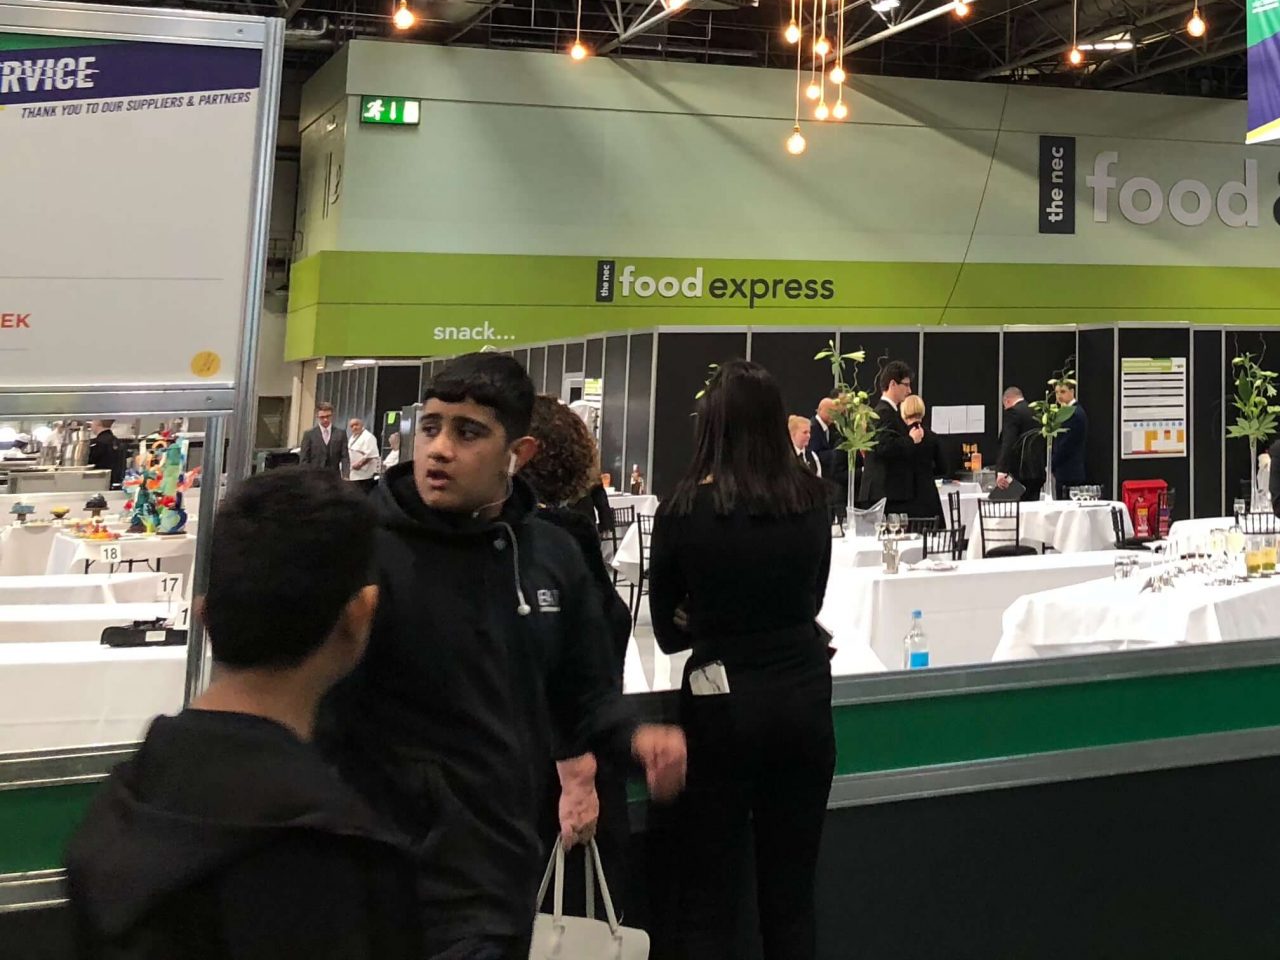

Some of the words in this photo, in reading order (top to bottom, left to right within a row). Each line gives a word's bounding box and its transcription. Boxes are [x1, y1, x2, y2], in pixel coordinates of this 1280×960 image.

[21, 106, 57, 119] THANK
[62, 104, 82, 116] YOU
[86, 102, 100, 114] TO
[101, 102, 123, 113] OUR
[126, 97, 184, 111] SUPPLIERS
[186, 96, 195, 107] &
[198, 91, 251, 106] PARTNERS
[1051, 147, 1064, 183] nec
[1085, 151, 1258, 228] food
[1046, 187, 1064, 223] the
[600, 282, 610, 297] the
[618, 265, 704, 299] food
[708, 276, 835, 310] express
[433, 320, 516, 340] snack...
[103, 547, 118, 560] 18
[161, 577, 179, 592] 17
